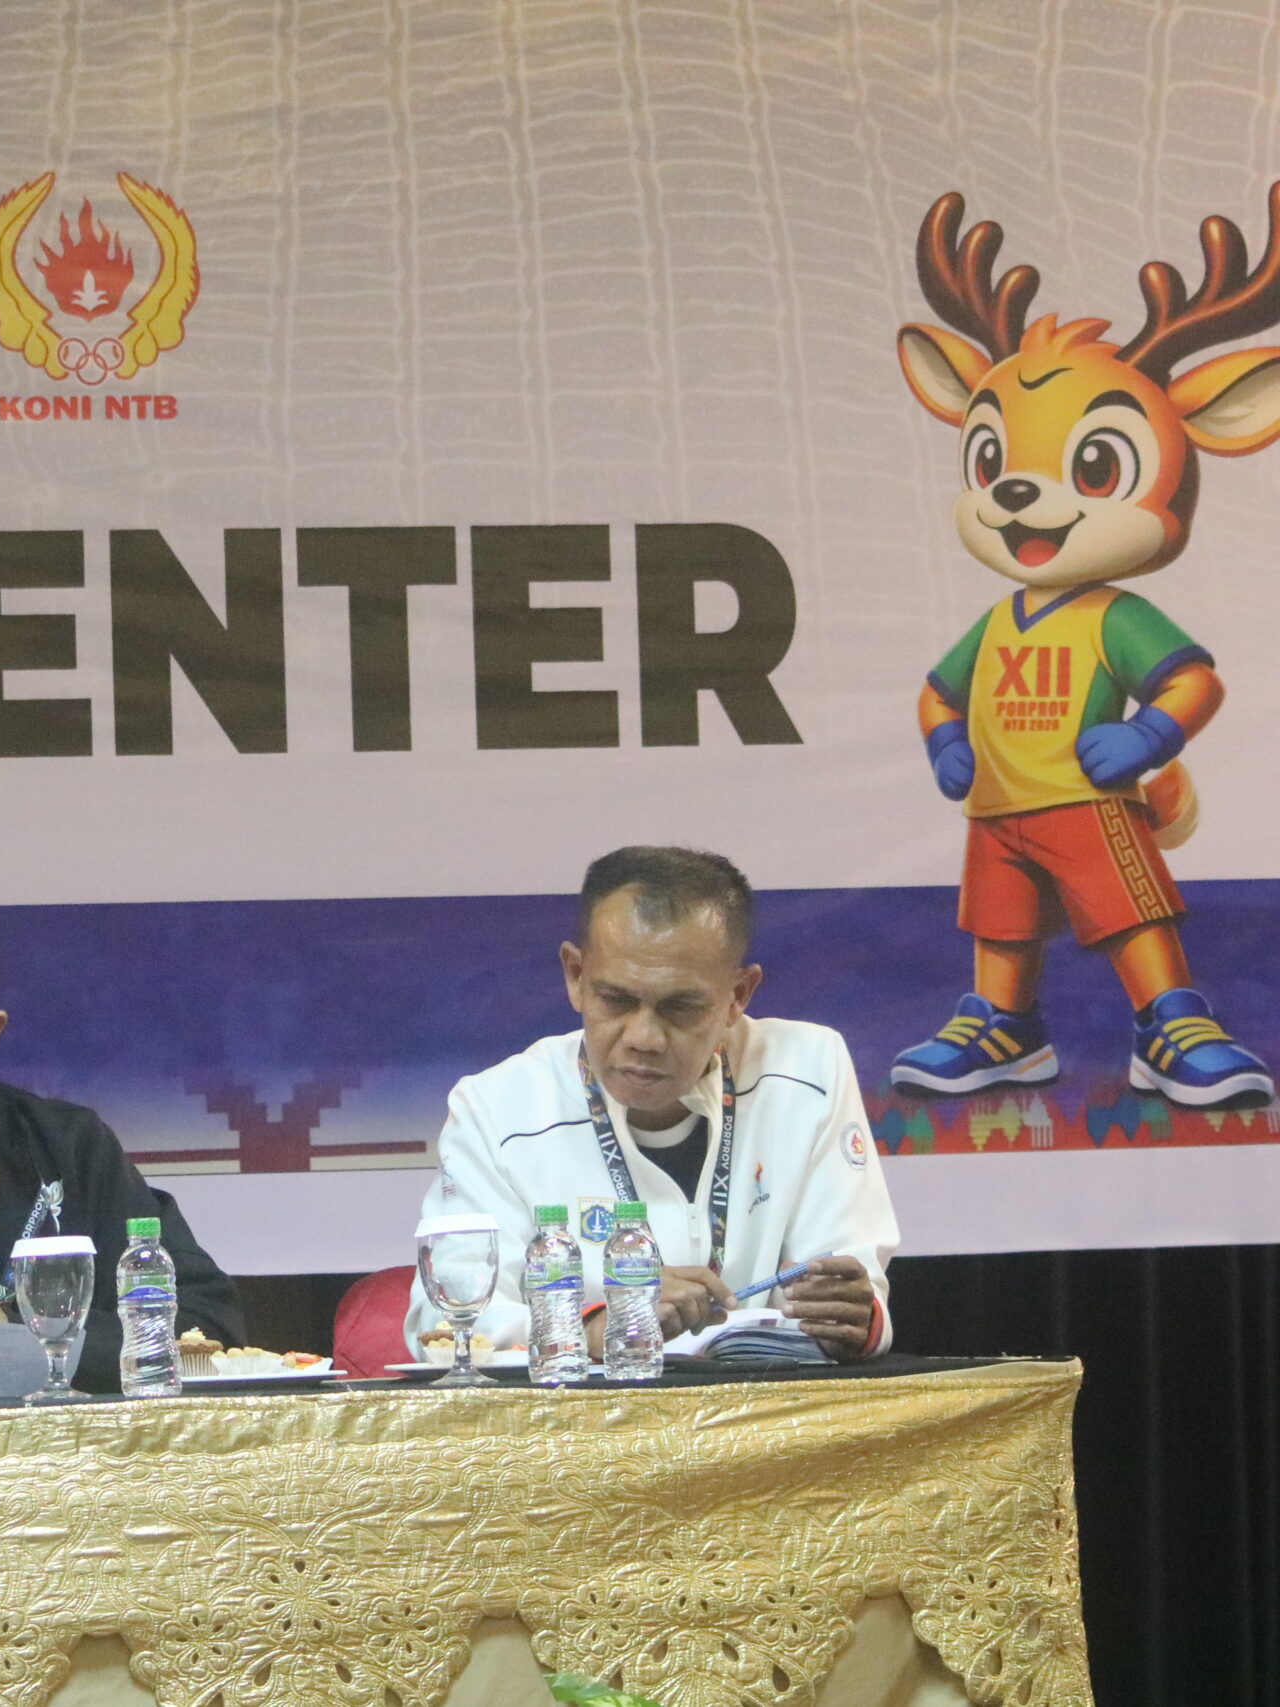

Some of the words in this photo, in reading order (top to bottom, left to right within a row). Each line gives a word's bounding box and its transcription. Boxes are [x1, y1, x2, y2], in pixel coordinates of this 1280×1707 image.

[104, 394, 178, 420] NTB
[992, 646, 1071, 698] XII
[995, 701, 1069, 717] PORPROV
[598, 1131, 623, 1165] XII
[721, 1115, 733, 1170] PORPROV
[712, 1172, 730, 1207] XII
[22, 1193, 46, 1240] ORPROV
